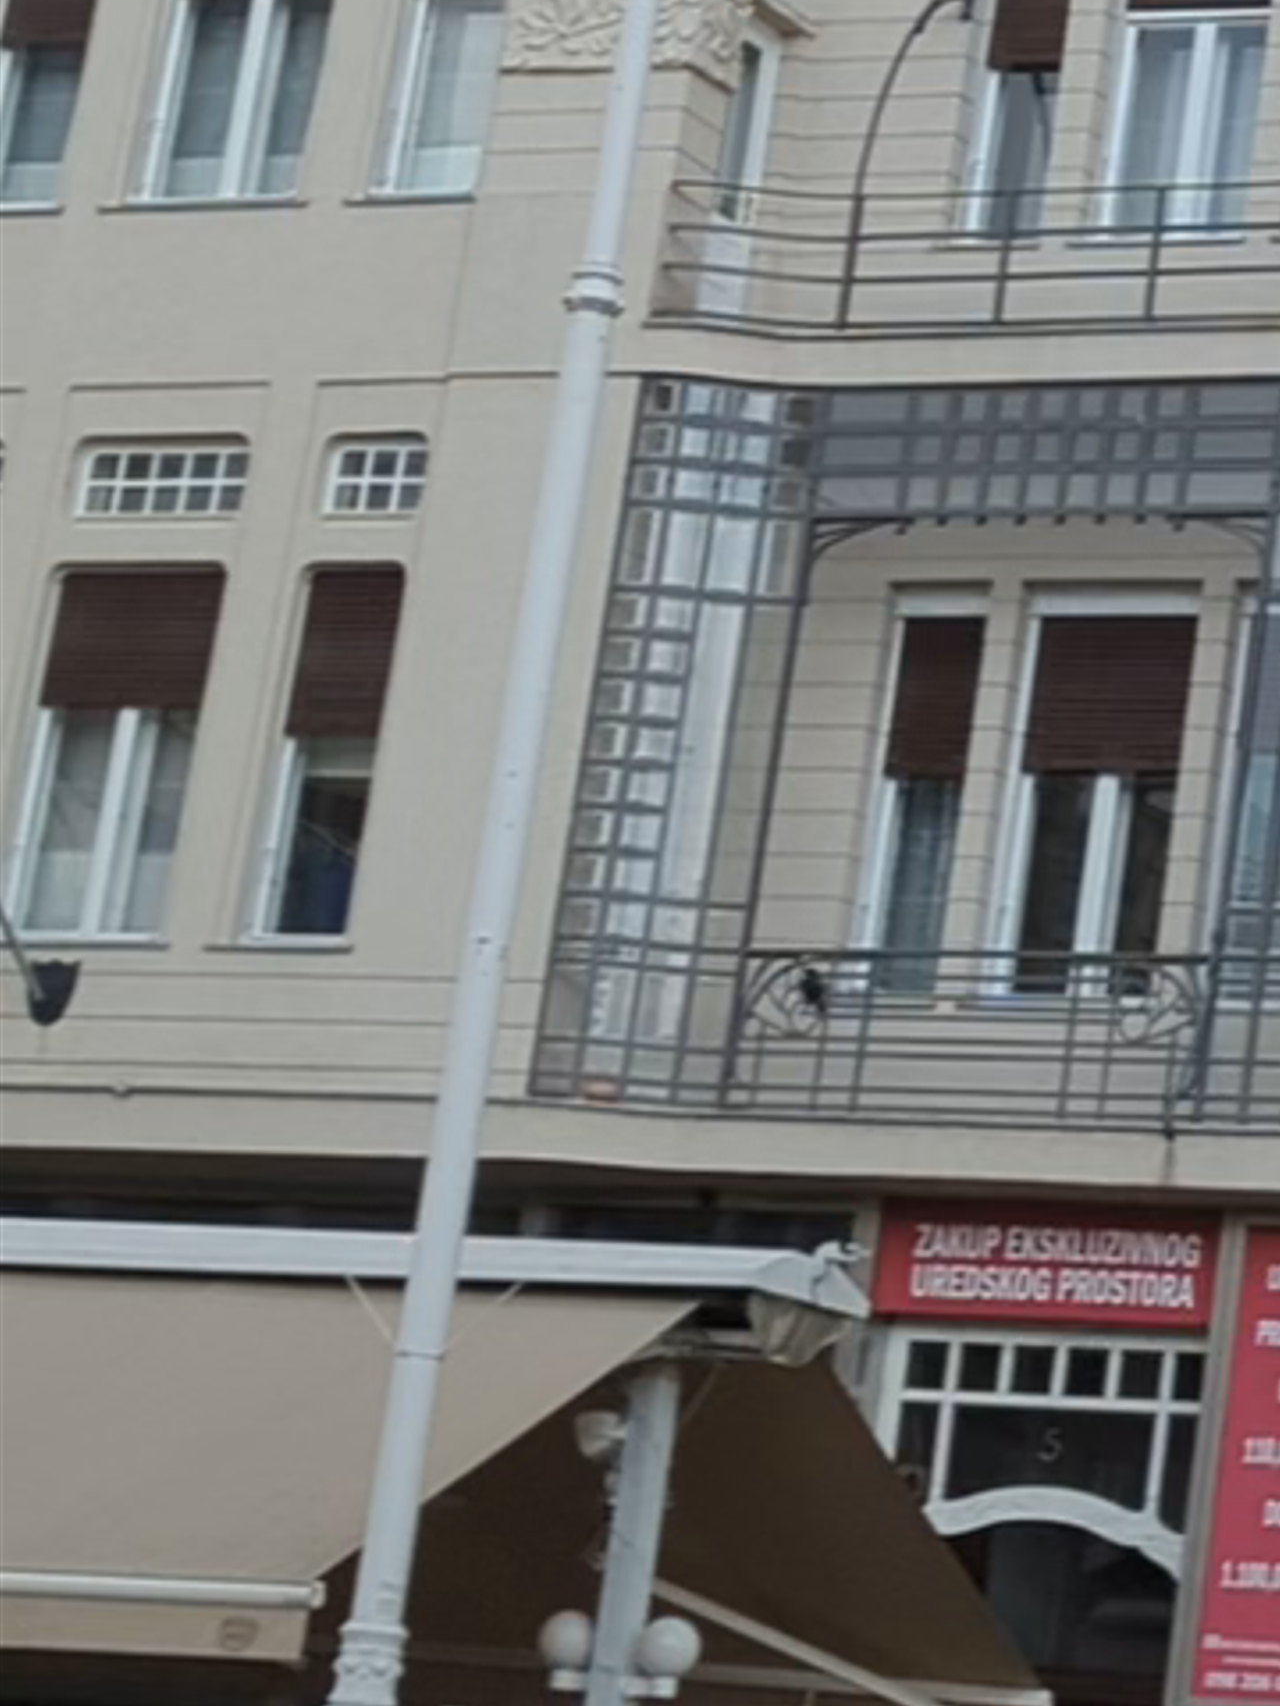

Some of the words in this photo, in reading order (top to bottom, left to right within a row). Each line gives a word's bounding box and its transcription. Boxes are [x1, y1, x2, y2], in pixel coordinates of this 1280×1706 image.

[912, 1223, 1001, 1259] ZAKUP
[1004, 1225, 1202, 1268] EKSKLUZIVNOG
[910, 1263, 1051, 1300] UREDSKOG
[1055, 1267, 1195, 1308] PROSTORA
